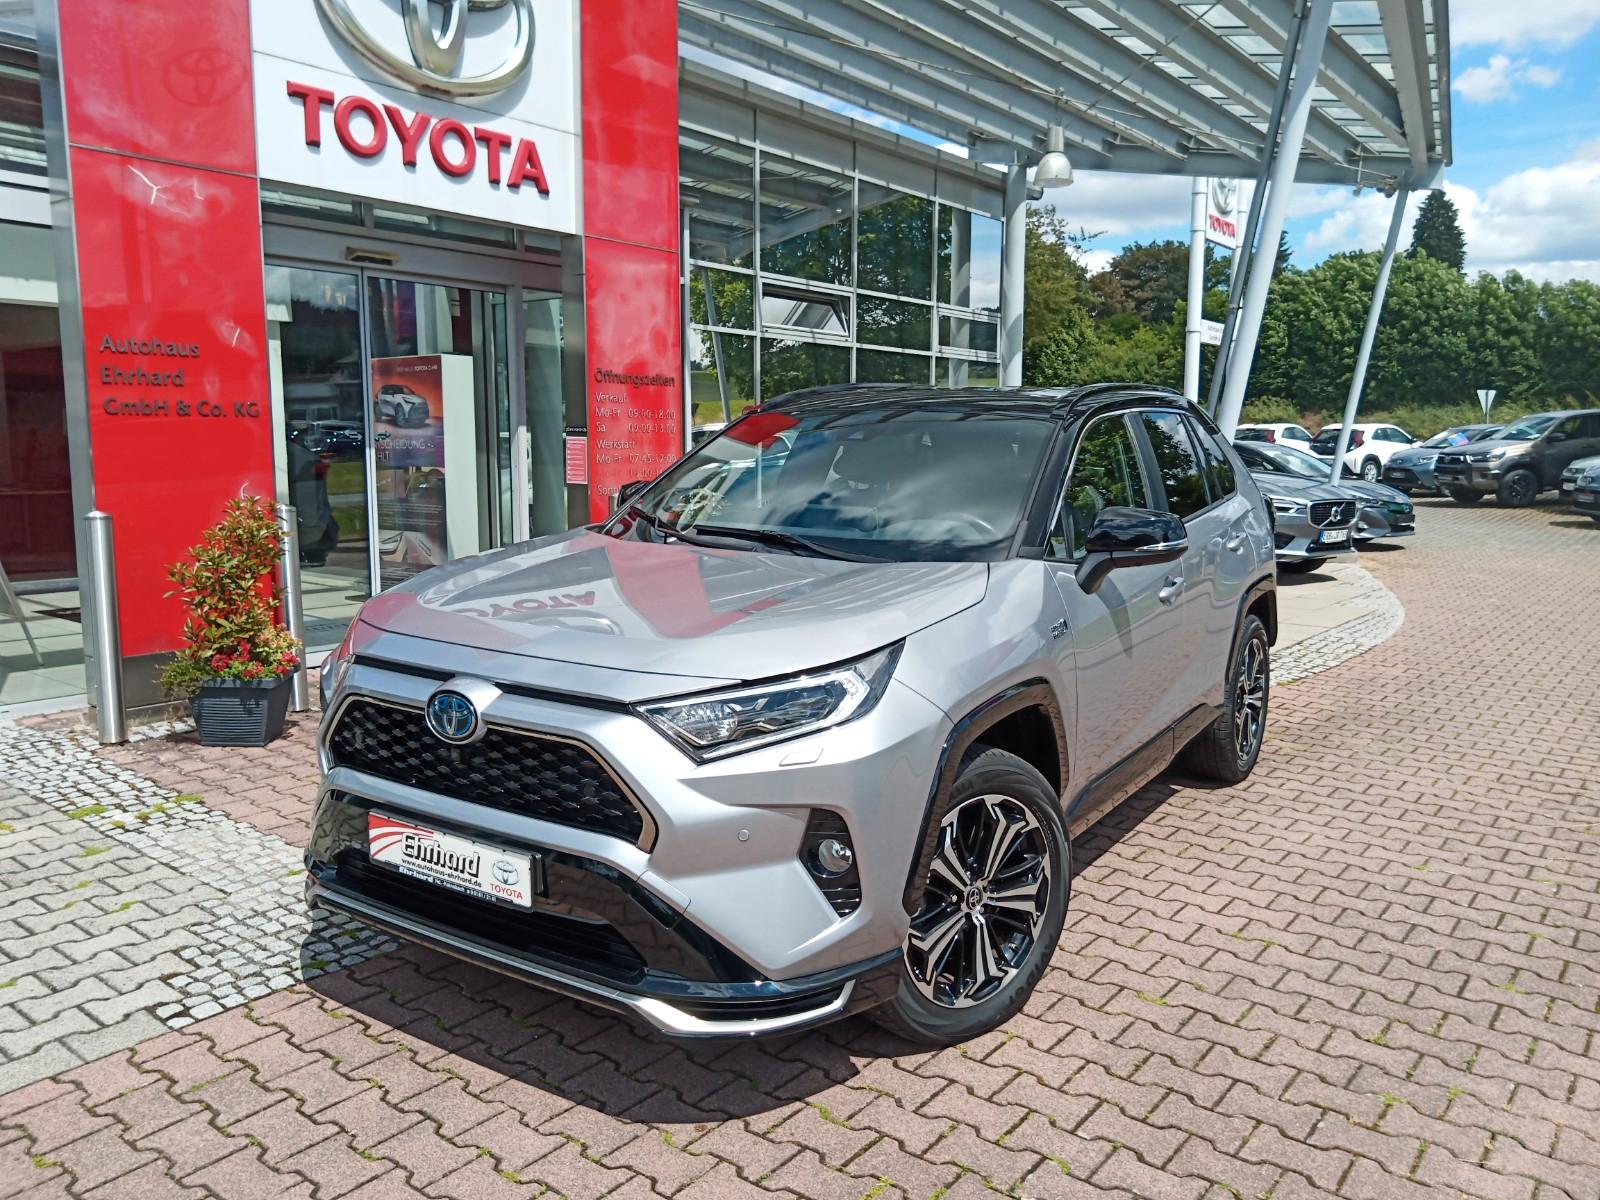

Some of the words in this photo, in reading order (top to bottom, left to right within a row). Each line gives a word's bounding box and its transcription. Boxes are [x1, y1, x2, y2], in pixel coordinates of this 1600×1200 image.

[286, 80, 551, 197] TOYOTA
[1208, 213, 1236, 239] TOYOTA
[100, 334, 201, 358] Autohaus
[101, 366, 185, 387] Ehrhard
[594, 367, 675, 388] Öffnungszeiten
[103, 398, 169, 417] GmbH
[176, 401, 191, 416] &
[197, 401, 228, 417] Co.
[234, 401, 260, 418] KG
[400, 831, 481, 878] Ehrhard
[401, 857, 482, 888] www.autohaus-ehrhard.de
[490, 883, 524, 900] TOYOTA
